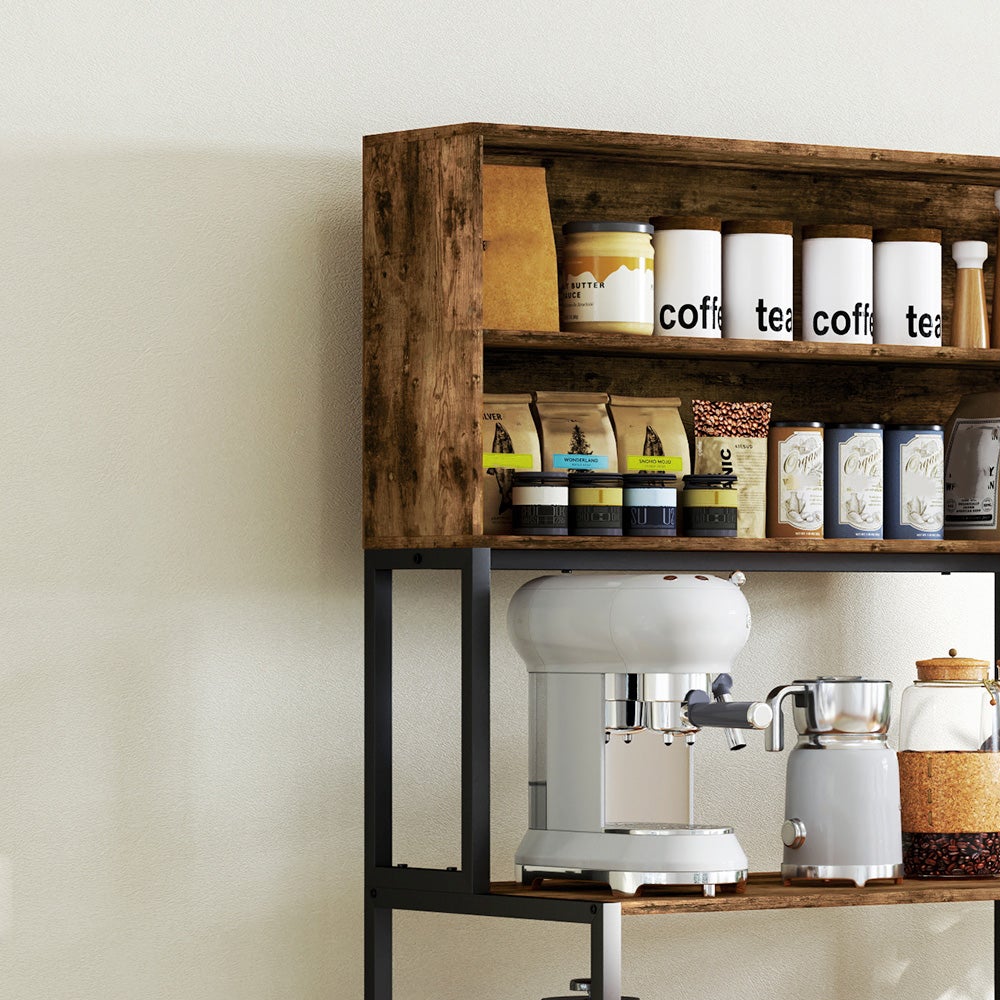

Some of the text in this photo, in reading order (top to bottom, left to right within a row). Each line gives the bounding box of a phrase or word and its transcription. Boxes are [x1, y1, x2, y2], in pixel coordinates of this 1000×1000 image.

[571, 282, 605, 290] BUTTER
[755, 298, 793, 333] tea
[906, 305, 941, 338] tea
